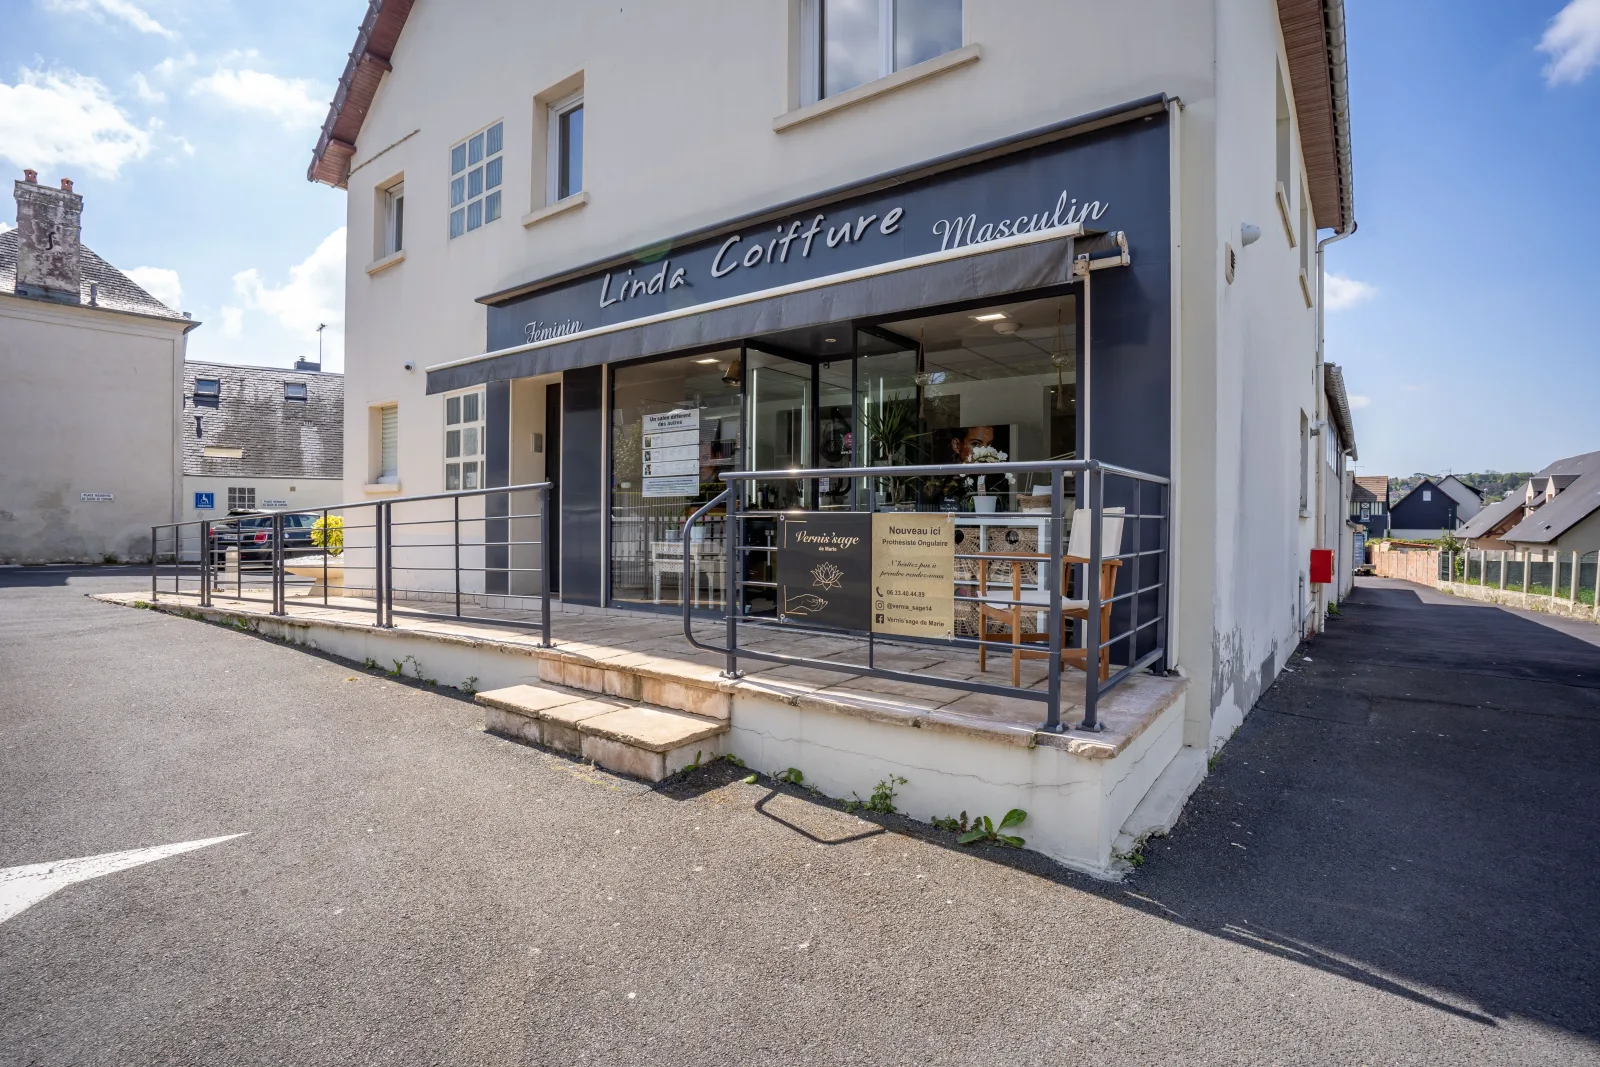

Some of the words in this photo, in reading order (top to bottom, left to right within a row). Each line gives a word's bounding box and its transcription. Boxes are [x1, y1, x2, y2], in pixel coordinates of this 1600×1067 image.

[932, 189, 1109, 252] Masculin
[600, 259, 687, 308] Linda
[710, 206, 904, 279] Coiffure
[524, 318, 583, 344] Féminin
[889, 525, 928, 536] Nouveau
[930, 526, 941, 535] ici
[795, 530, 860, 549] Vernis'sage
[882, 538, 917, 546] Prothésiste
[886, 602, 932, 612] @vernis_sage14
[886, 616, 919, 626] Vernis'sage
